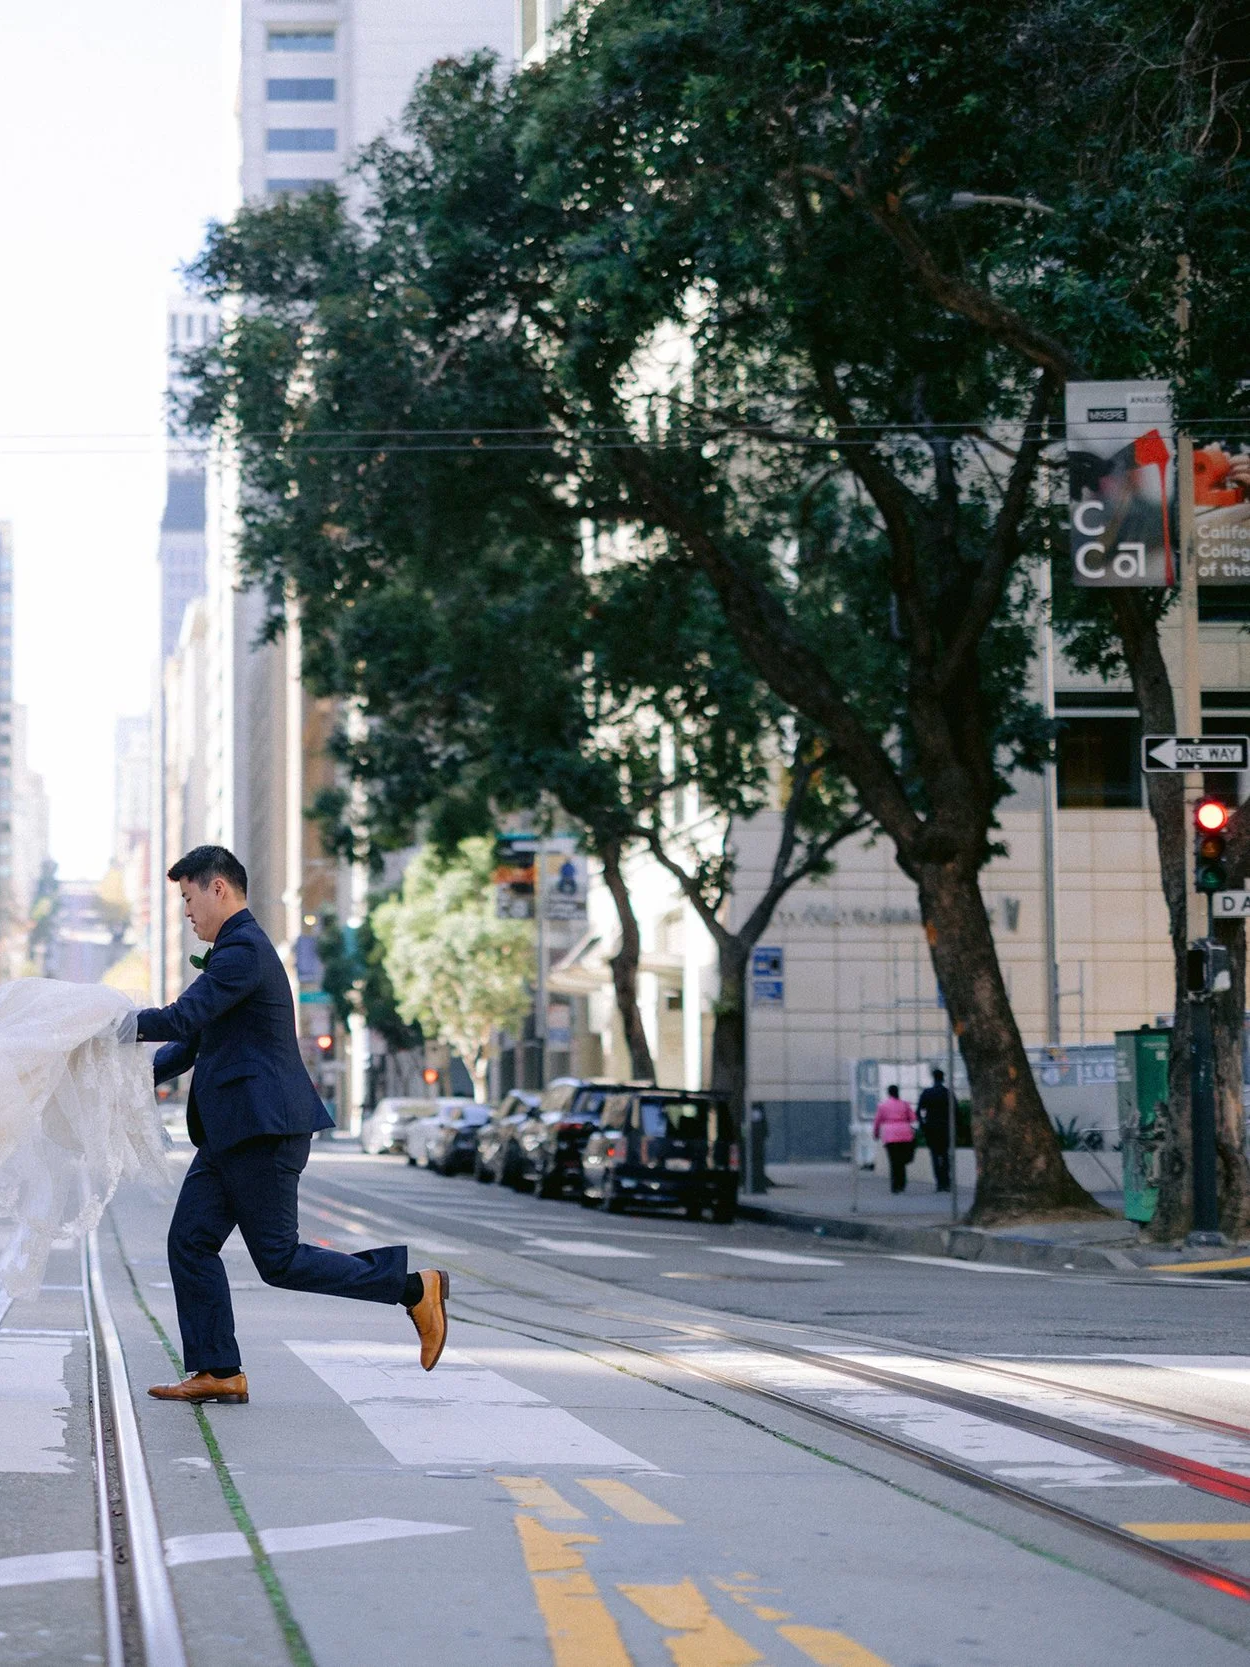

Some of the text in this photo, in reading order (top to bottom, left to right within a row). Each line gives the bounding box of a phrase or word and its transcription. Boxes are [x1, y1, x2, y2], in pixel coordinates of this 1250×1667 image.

[1073, 501, 1106, 536] C
[1198, 560, 1250, 577] of the
[1175, 747, 1237, 761] ONE WAY
